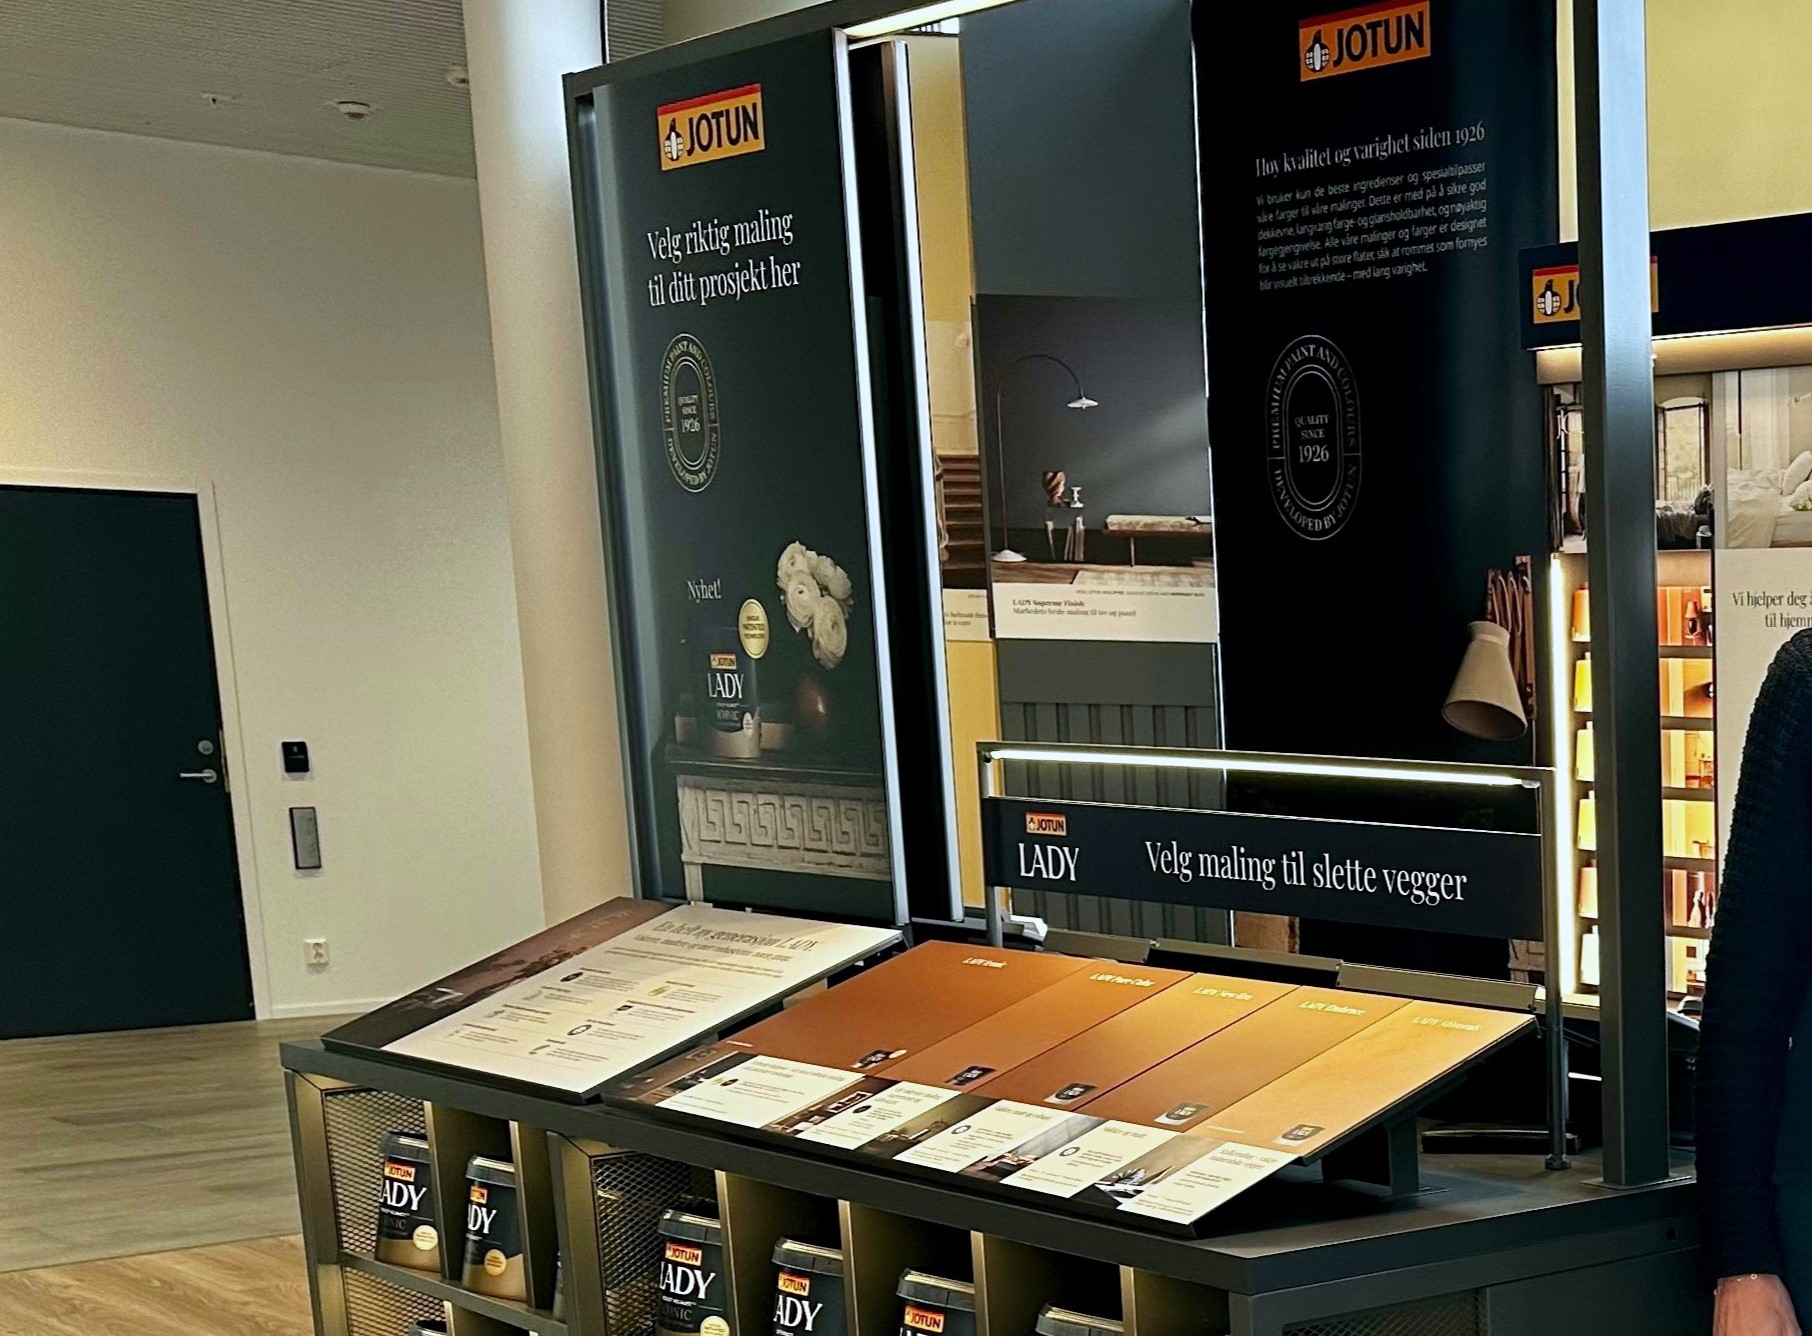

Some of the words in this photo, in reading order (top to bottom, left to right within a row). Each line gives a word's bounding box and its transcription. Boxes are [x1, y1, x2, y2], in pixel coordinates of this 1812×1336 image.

[1333, 22, 1425, 67] JOTUN
[686, 103, 759, 157] JOTUN
[1283, 147, 1331, 173] kvalitet
[1335, 147, 1351, 167] og
[1352, 133, 1410, 160] varighet
[1413, 126, 1452, 151] siden
[1455, 120, 1486, 148] 1926
[1405, 188, 1424, 202] med
[1426, 185, 1437, 201] på
[1469, 178, 1487, 194] god
[1407, 172, 1419, 184] og
[647, 227, 683, 264] Velg
[685, 218, 730, 255] riktig
[733, 209, 794, 246] maling
[1398, 228, 1409, 241] og
[648, 274, 665, 306] til
[669, 271, 697, 304] ditt
[699, 259, 769, 306] prosjekt
[769, 256, 801, 288] her
[1284, 344, 1316, 370] PAINT
[1316, 345, 1339, 370] AND
[1298, 444, 1330, 464] 1926
[687, 578, 722, 603] Nyhet!
[1732, 592, 1744, 606] Vi
[1747, 590, 1784, 609] hjelper
[1787, 590, 1807, 608] deg
[1765, 613, 1777, 628] til
[708, 672, 744, 698] LADY
[1035, 817, 1066, 834] JOTUN
[1018, 842, 1080, 883] LADY
[1145, 840, 1193, 883] Velg
[1198, 845, 1277, 891] maling
[1281, 851, 1307, 887] til
[1313, 856, 1377, 894] slette
[1382, 867, 1468, 906] vegger
[380, 1180, 427, 1211] ADY
[670, 1248, 699, 1263] JOTUN
[781, 1278, 807, 1293] JOTUN
[773, 1295, 823, 1332] ADY
[910, 1312, 941, 1330] JOTUN
